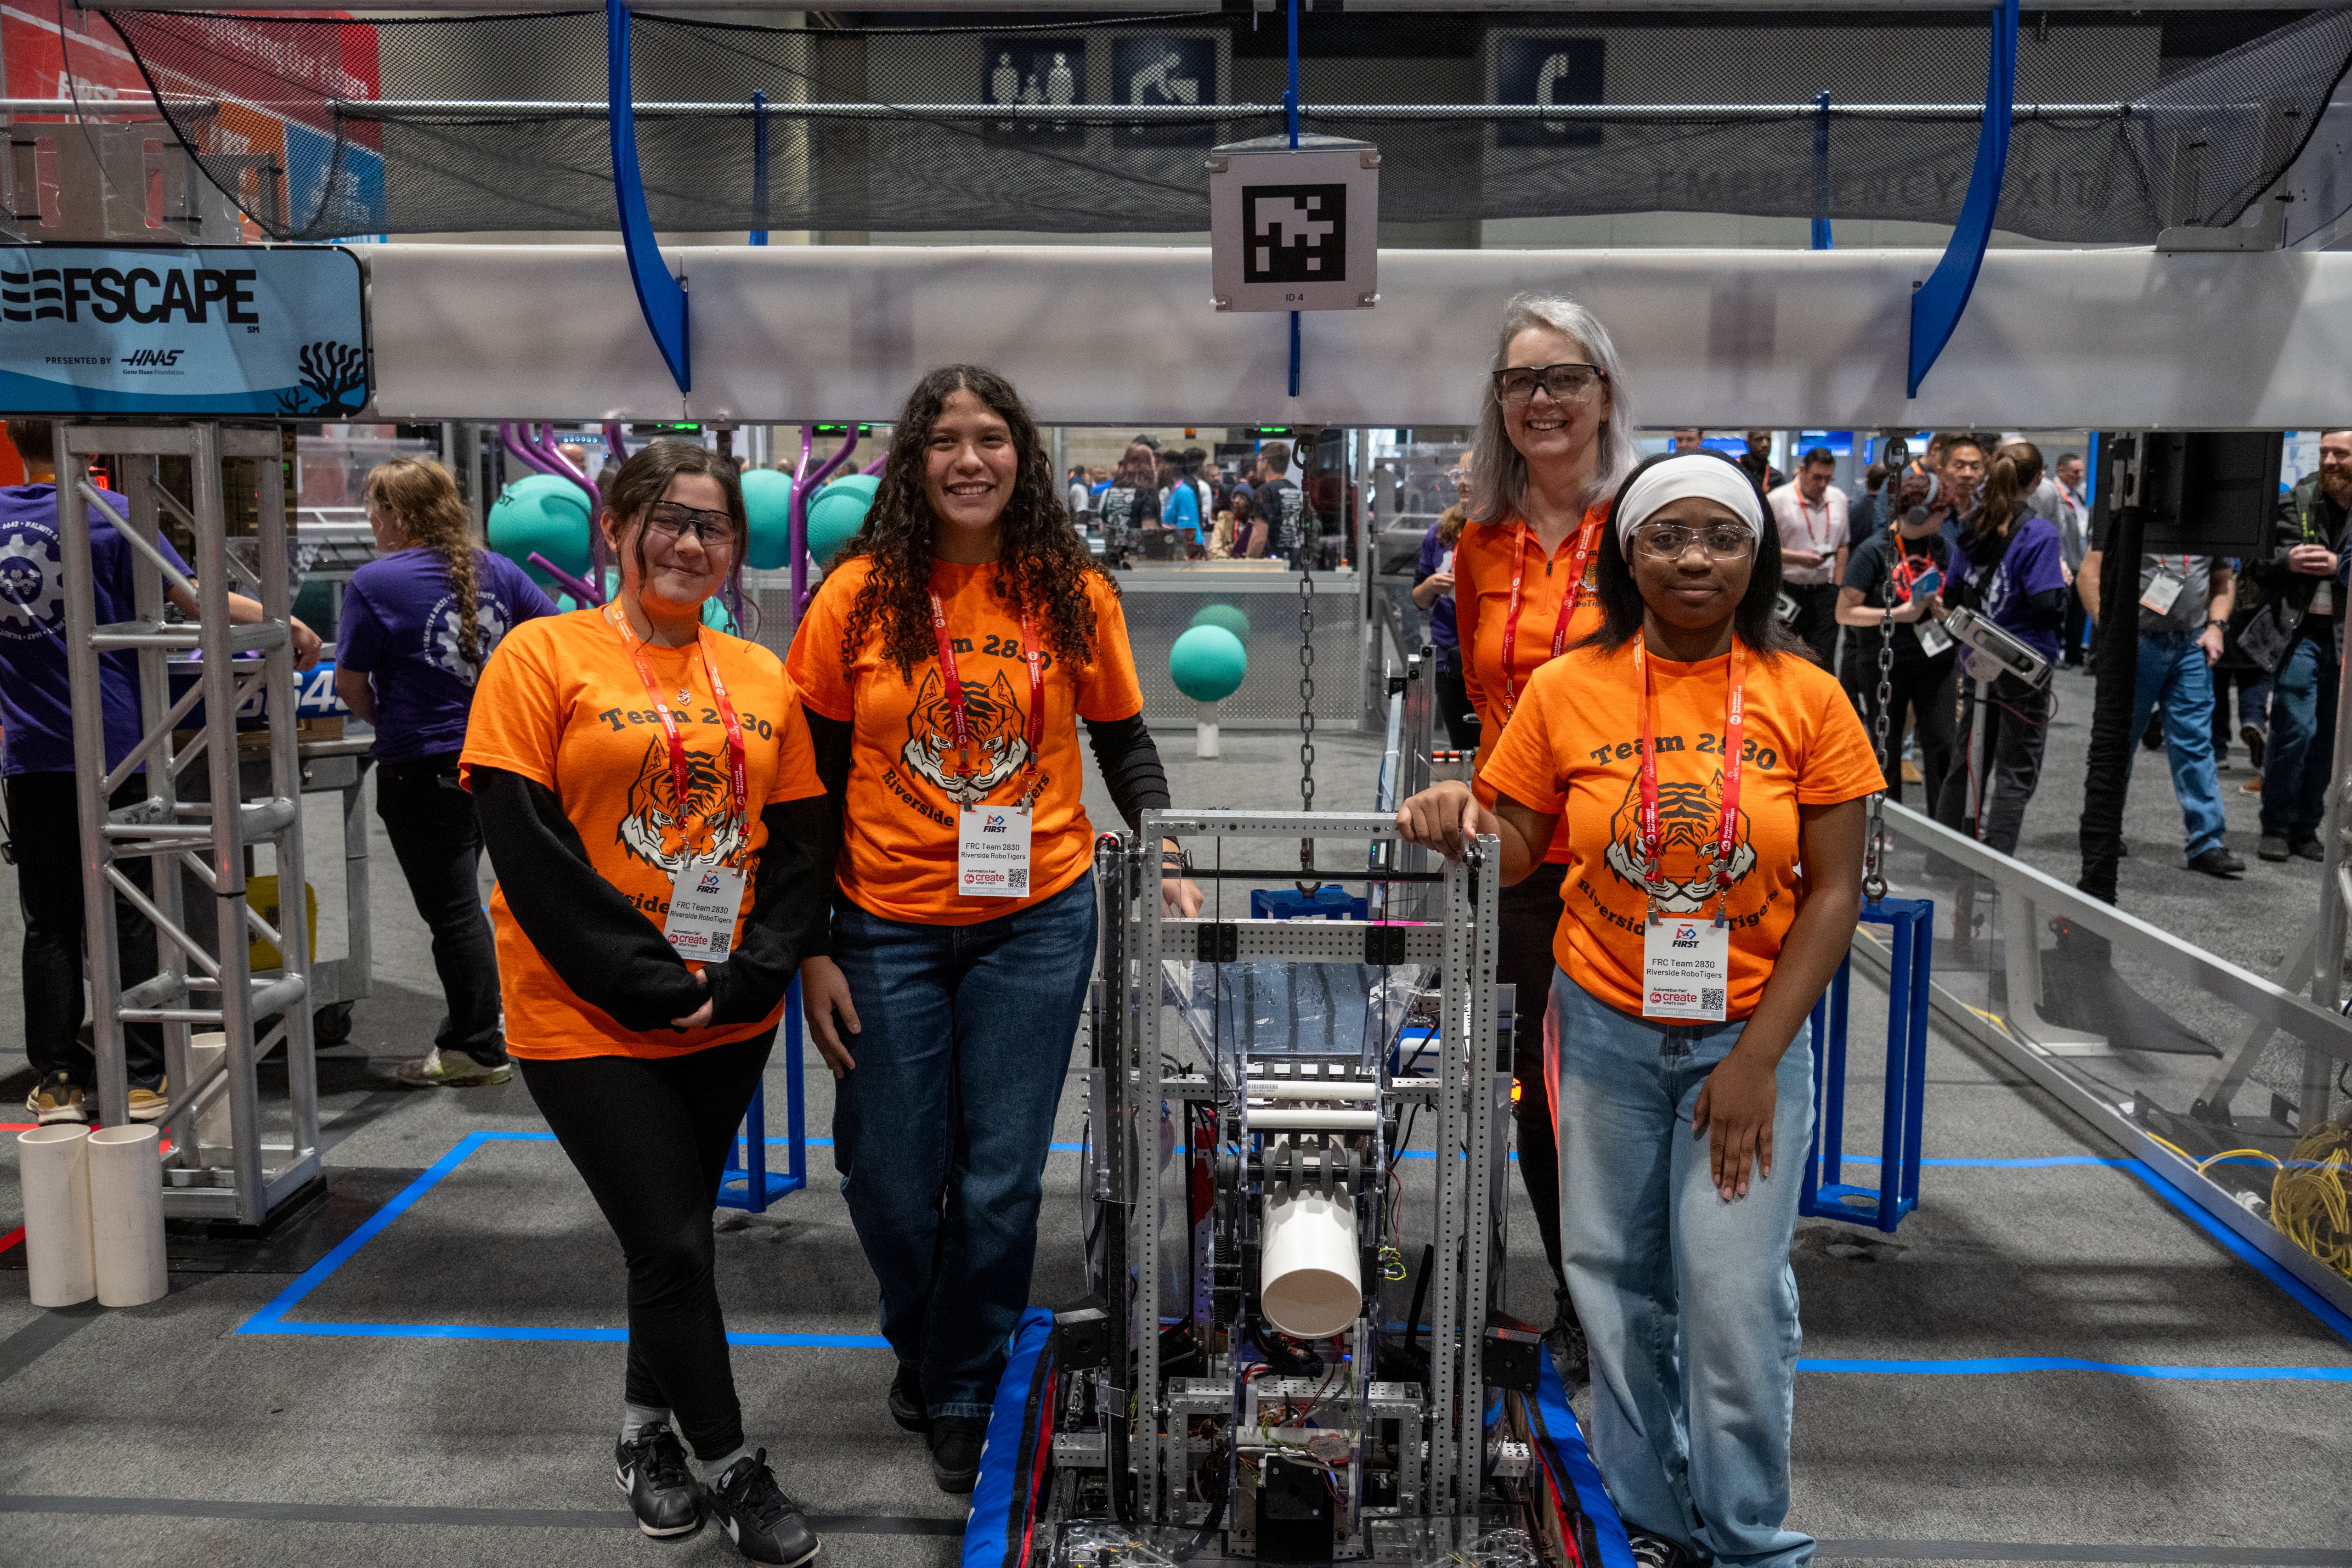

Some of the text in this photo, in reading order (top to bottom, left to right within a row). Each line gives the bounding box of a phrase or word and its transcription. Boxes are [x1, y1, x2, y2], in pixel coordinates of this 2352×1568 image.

[0, 268, 259, 323] EEFSCAPE
[121, 350, 185, 367] HAAS
[25, 521, 54, 536] WALNUTS
[1583, 525, 1592, 550] Automation
[618, 621, 630, 642] Automation
[599, 707, 772, 741] Team 230
[662, 713, 674, 739] Automation
[666, 713, 677, 733] Rockwell
[1590, 734, 1685, 767] Team
[882, 768, 954, 827] Riverside
[975, 874, 1005, 882] create
[696, 886, 720, 894] FIRST
[676, 901, 728, 914] FRC Team 2830
[1577, 879, 1645, 936] Riversid
[670, 910, 732, 924] Riverside RoboTigers
[679, 935, 707, 945] create
[1681, 970, 1722, 979] RoboTigers
[1662, 993, 1697, 1002] create
[722, 1470, 732, 1483] NIKE
